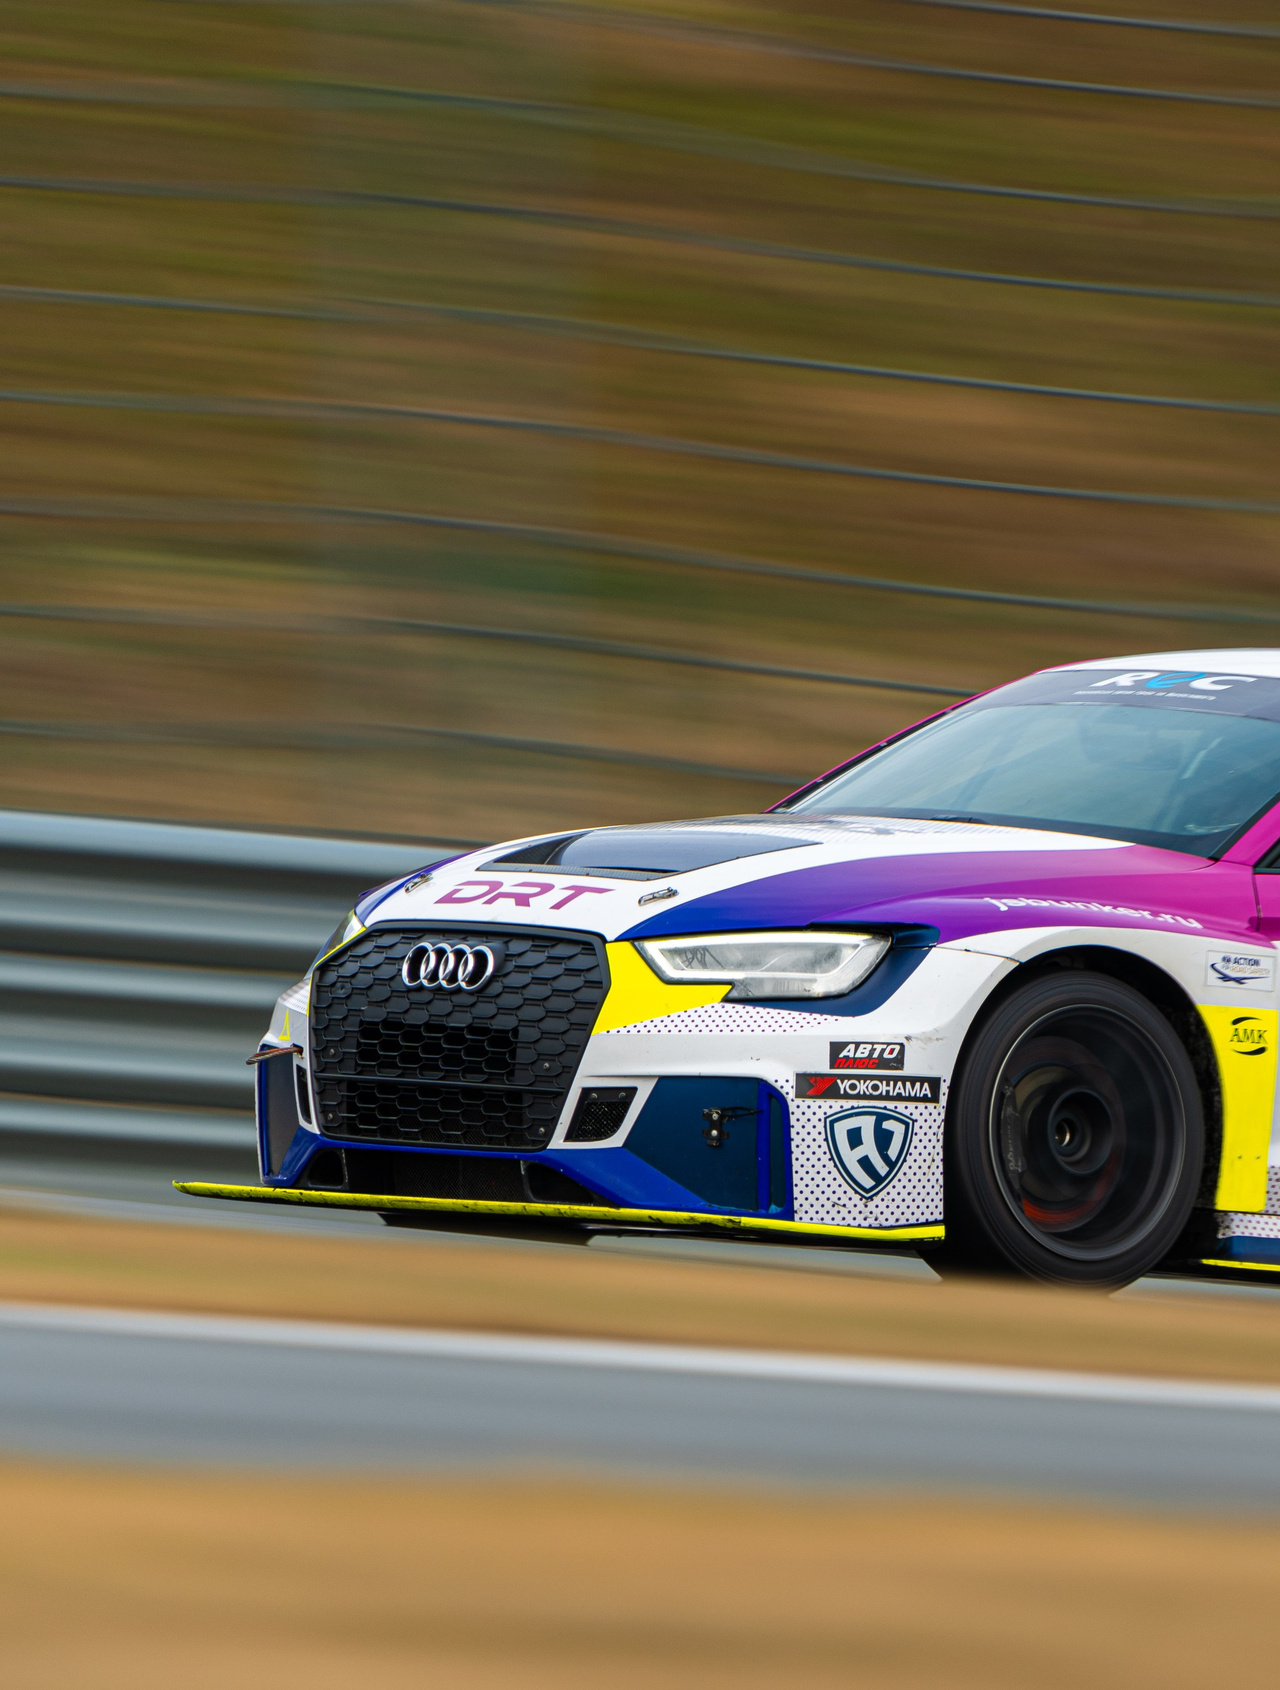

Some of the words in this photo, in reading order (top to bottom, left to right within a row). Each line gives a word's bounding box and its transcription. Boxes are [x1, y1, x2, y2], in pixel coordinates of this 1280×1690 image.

[433, 880, 616, 910] DRT
[1229, 1028, 1269, 1044] AMK
[838, 1043, 901, 1059] АВТО
[834, 1058, 879, 1068] ПЛЮС
[836, 1079, 932, 1098] YOKOHAMA
